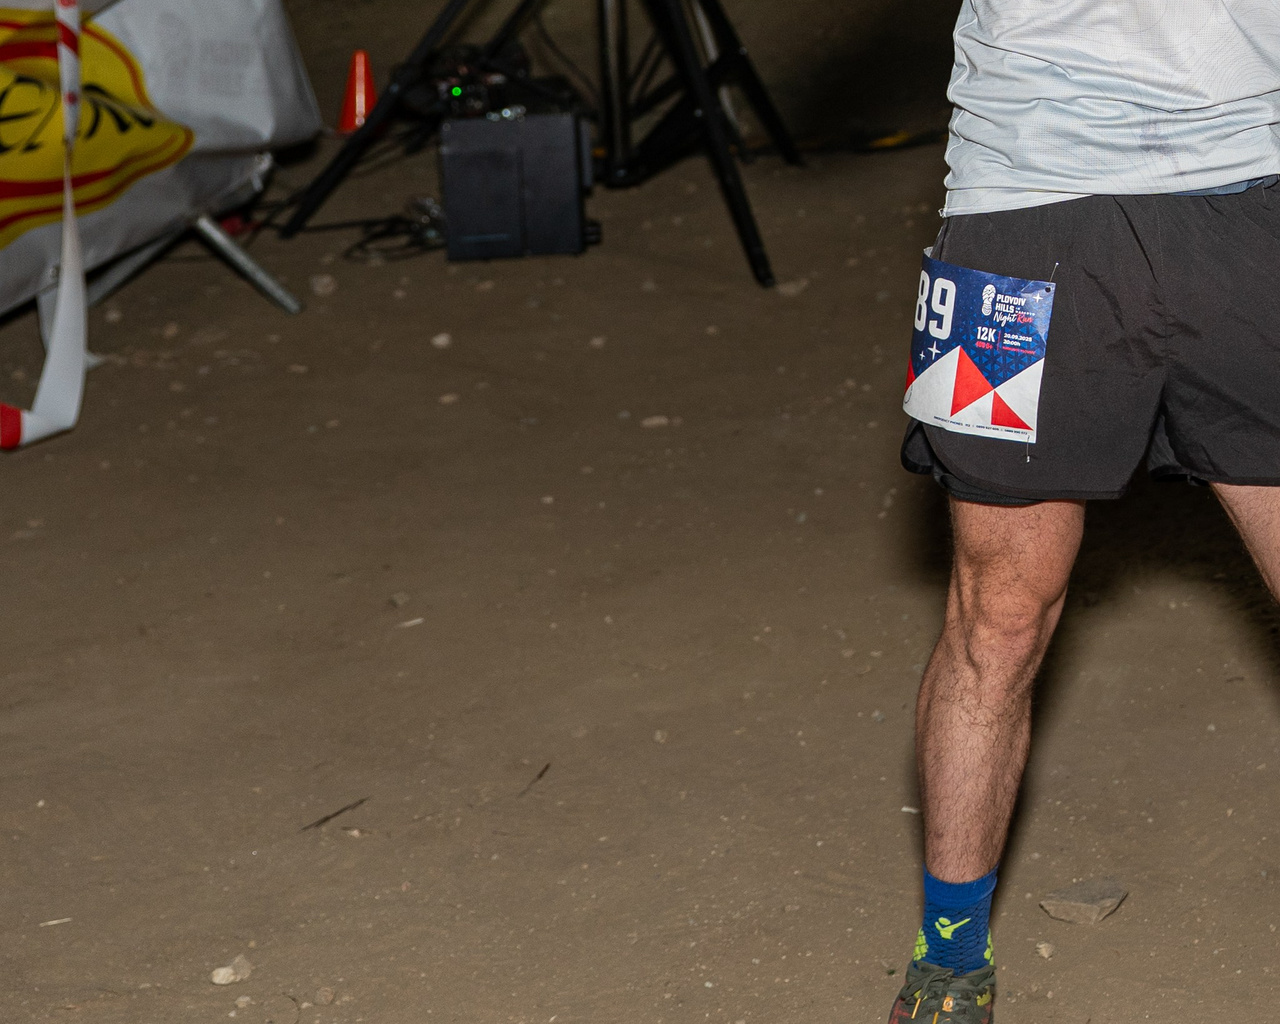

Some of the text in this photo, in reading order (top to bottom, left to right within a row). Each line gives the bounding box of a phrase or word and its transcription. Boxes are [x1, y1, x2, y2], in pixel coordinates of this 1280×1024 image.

[996, 293, 1027, 306] PLOVDIV
[995, 302, 1015, 313] HILLS
[993, 312, 1034, 327] Night Run
[976, 326, 997, 343] 12K
